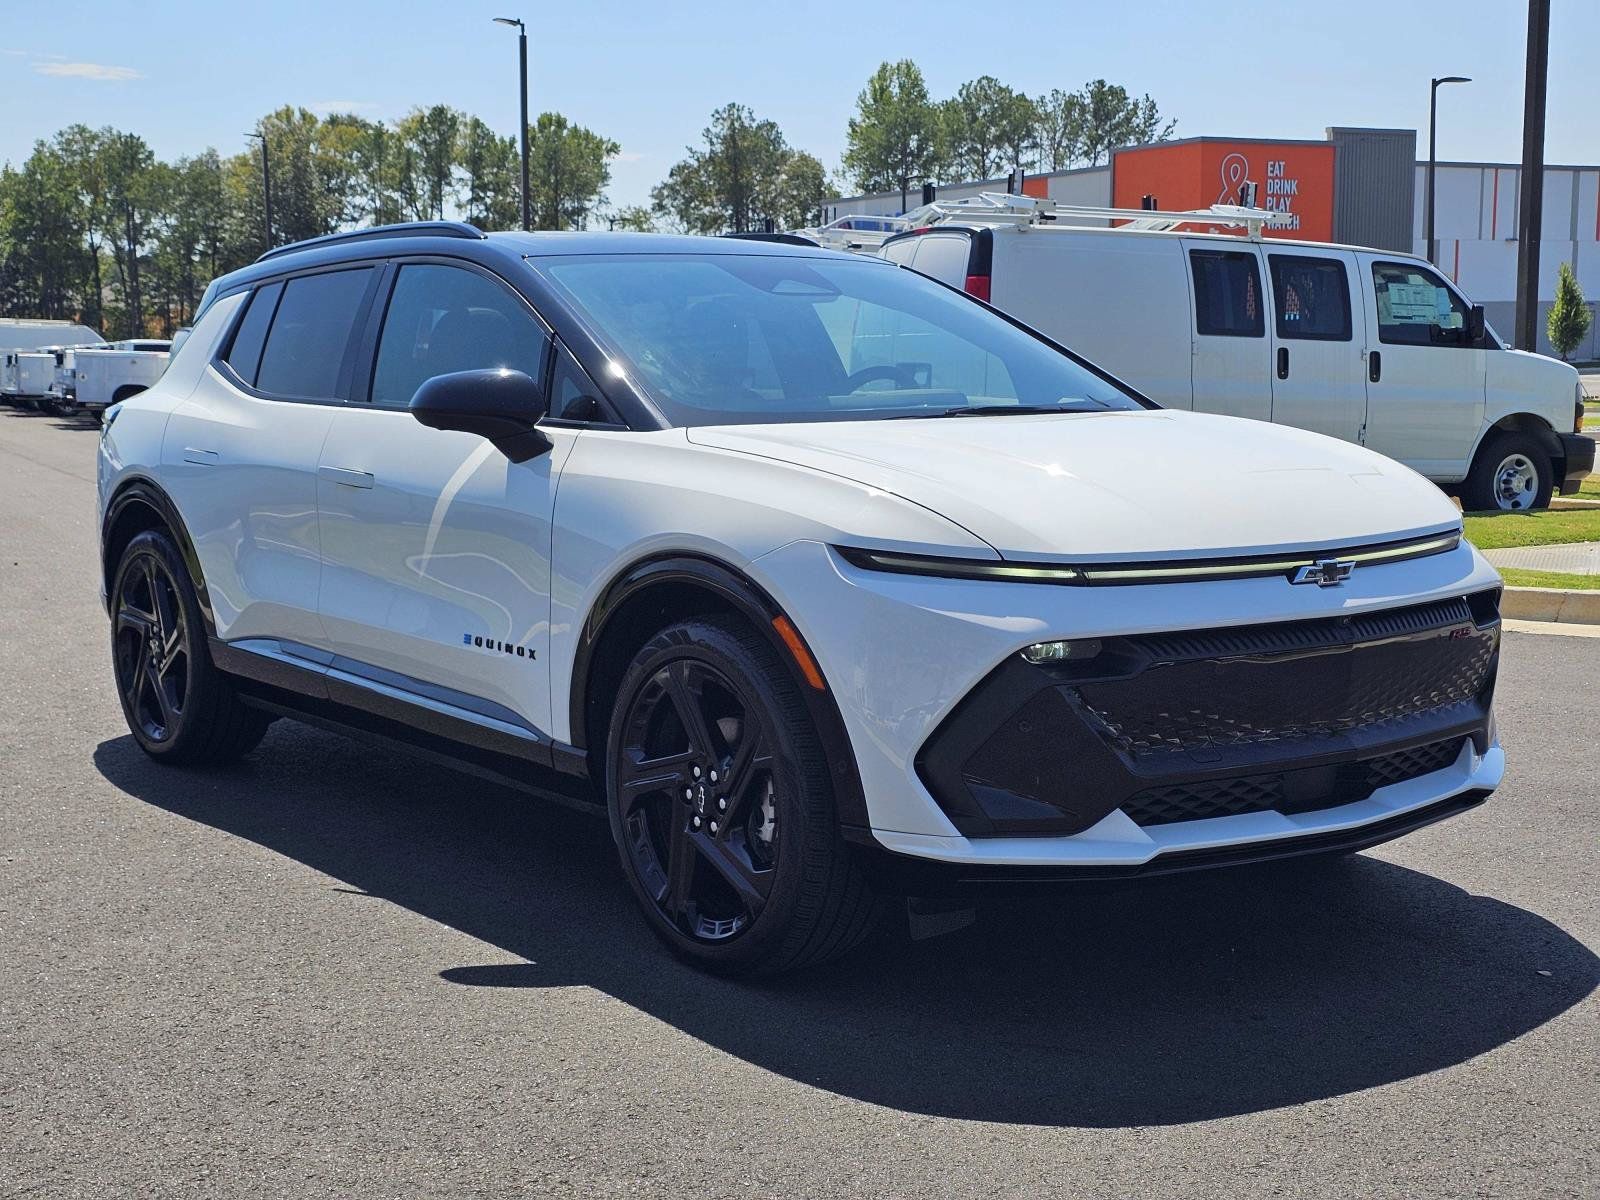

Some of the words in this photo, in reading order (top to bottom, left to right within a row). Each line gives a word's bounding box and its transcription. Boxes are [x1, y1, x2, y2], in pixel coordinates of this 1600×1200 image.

[1267, 161, 1285, 177] EAT
[1267, 179, 1298, 195] DRINK
[1266, 196, 1291, 212] PLAY
[463, 633, 537, 661] EQUINOX
